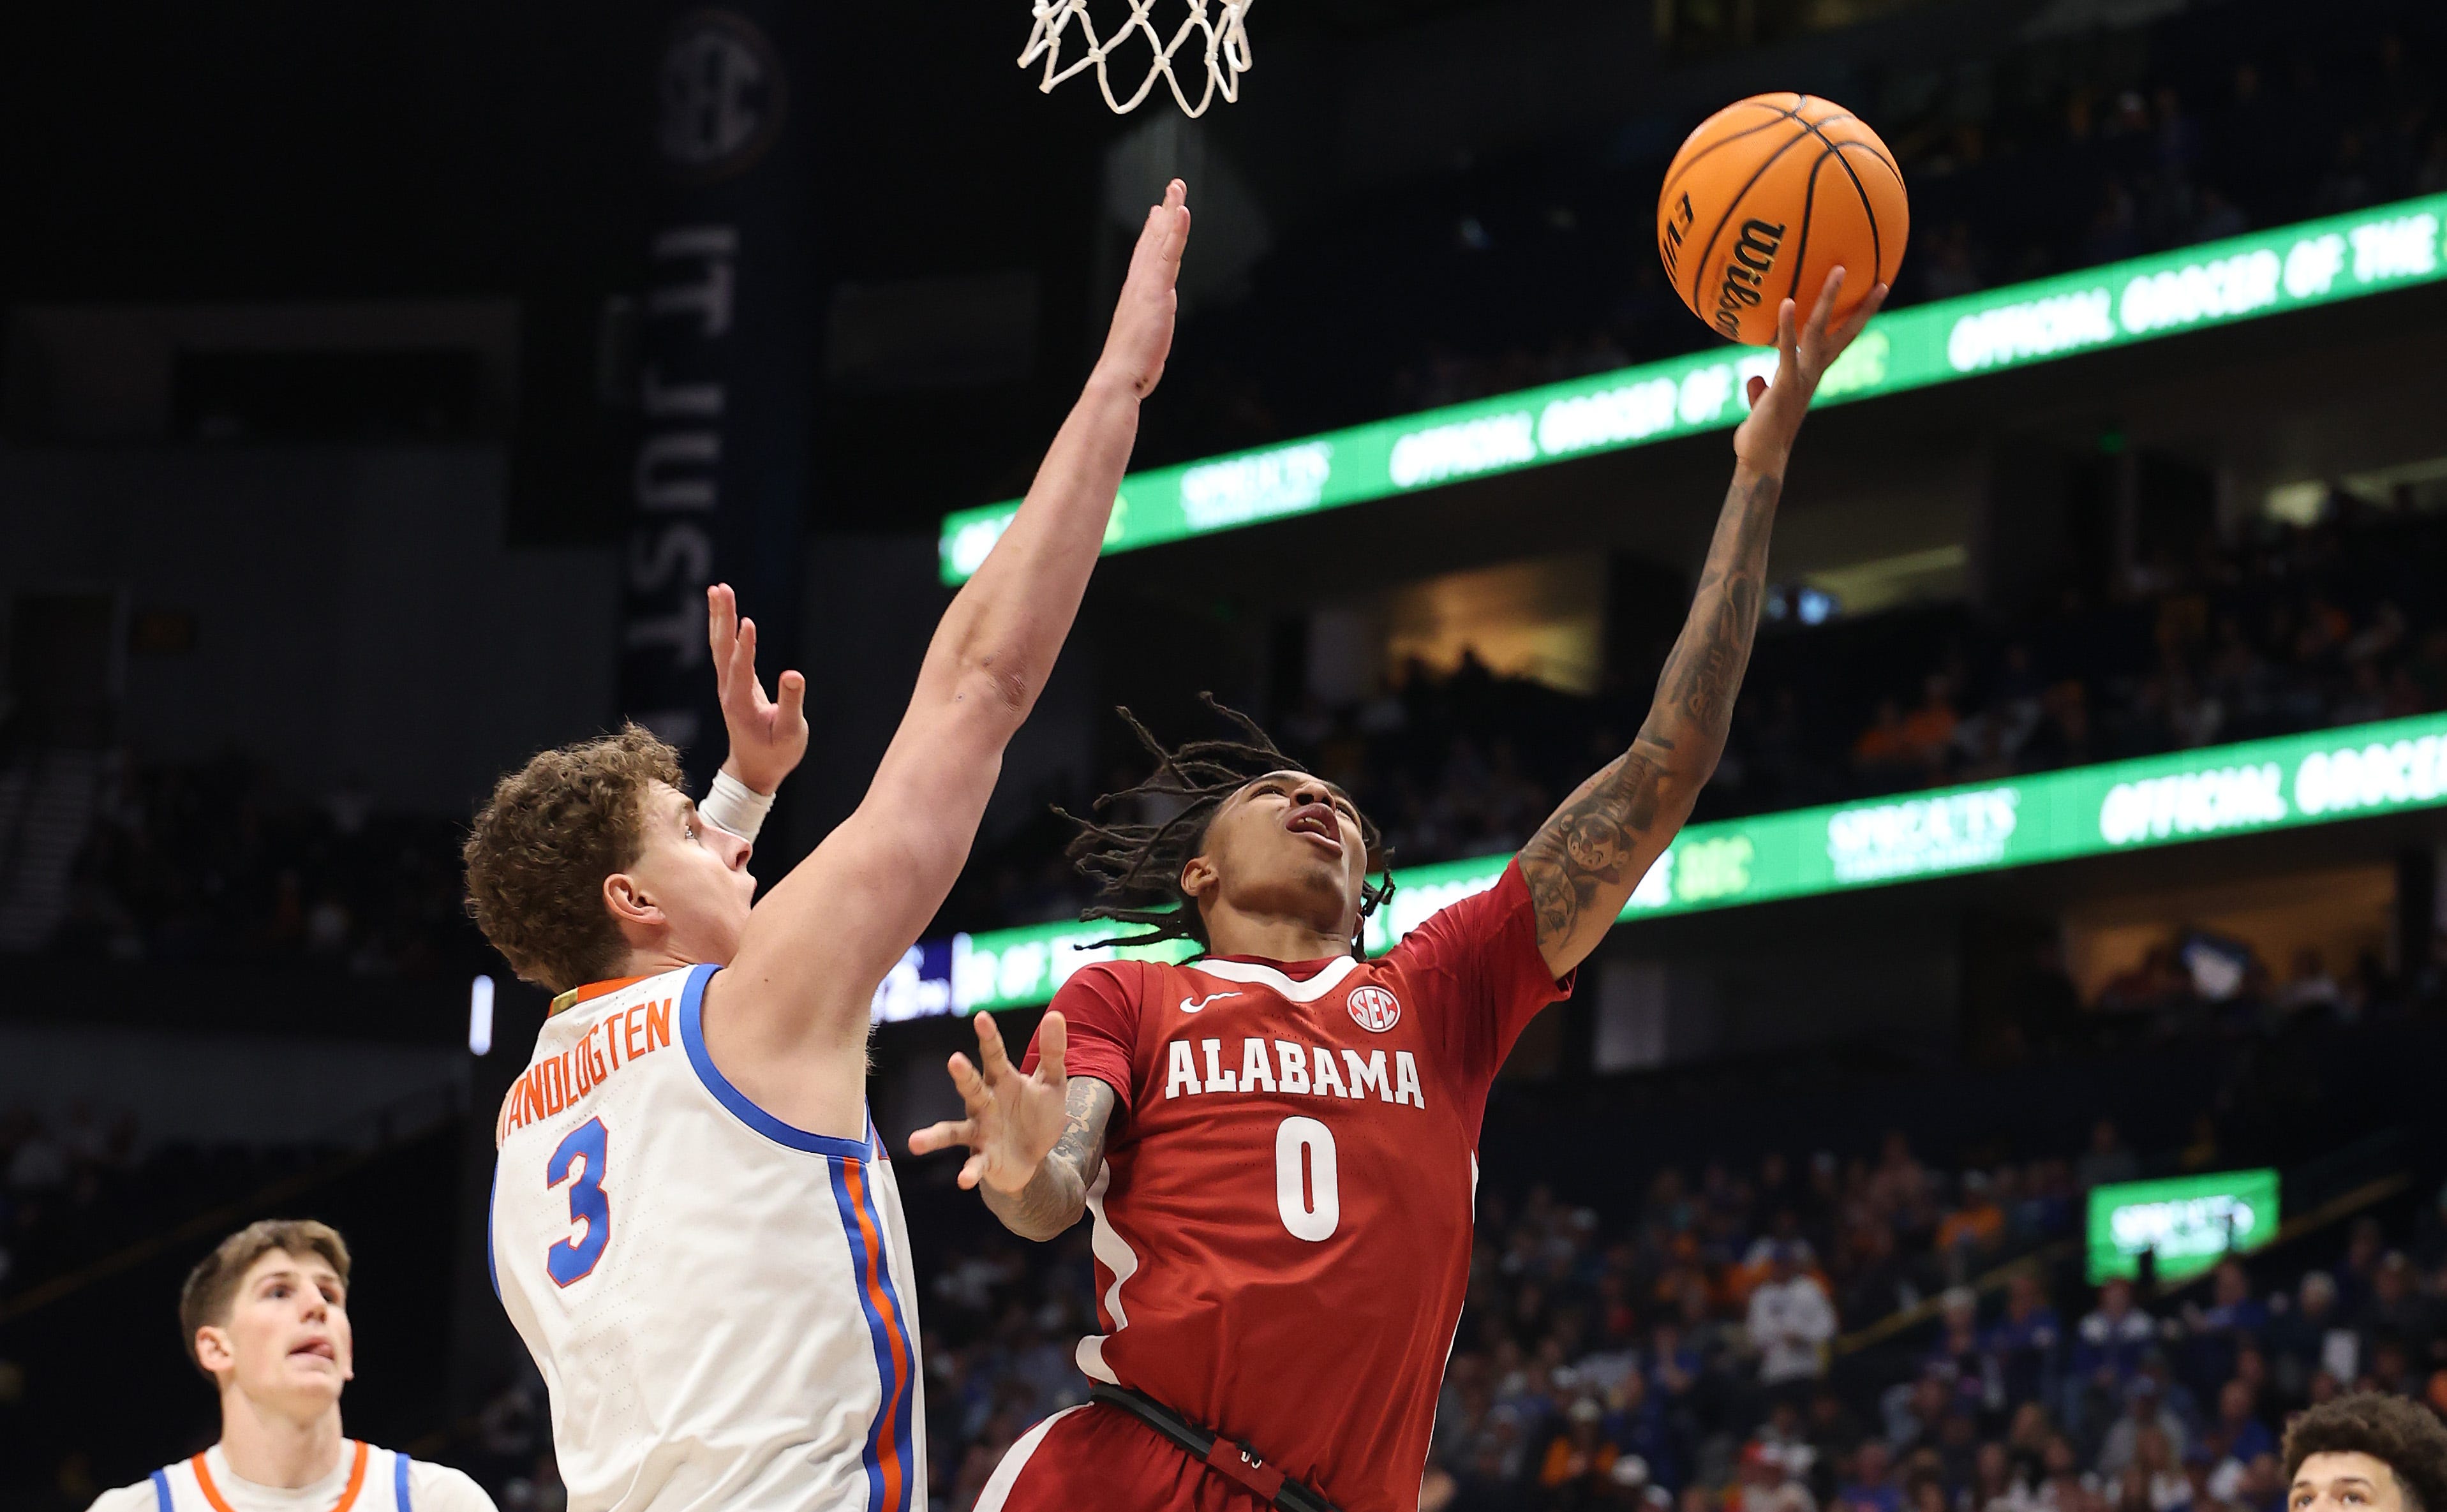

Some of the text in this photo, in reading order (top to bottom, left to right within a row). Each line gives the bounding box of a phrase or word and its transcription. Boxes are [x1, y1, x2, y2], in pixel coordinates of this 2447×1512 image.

[648, 225, 737, 336] IT
[1948, 213, 2438, 371] OFFICIAL GROCER OF THE
[1389, 411, 1536, 487] OFFICIAL
[1538, 376, 1678, 454] GROCER
[1679, 362, 1737, 424] OF
[629, 382, 724, 667] JUST
[2099, 762, 2288, 845] OFFICIAL
[2294, 732, 2447, 815] GROCE
[1351, 989, 1396, 1028] SEC
[1165, 1037, 1425, 1109] ALABAMA
[547, 1115, 610, 1289] 3
[1276, 1116, 1340, 1242] 0
